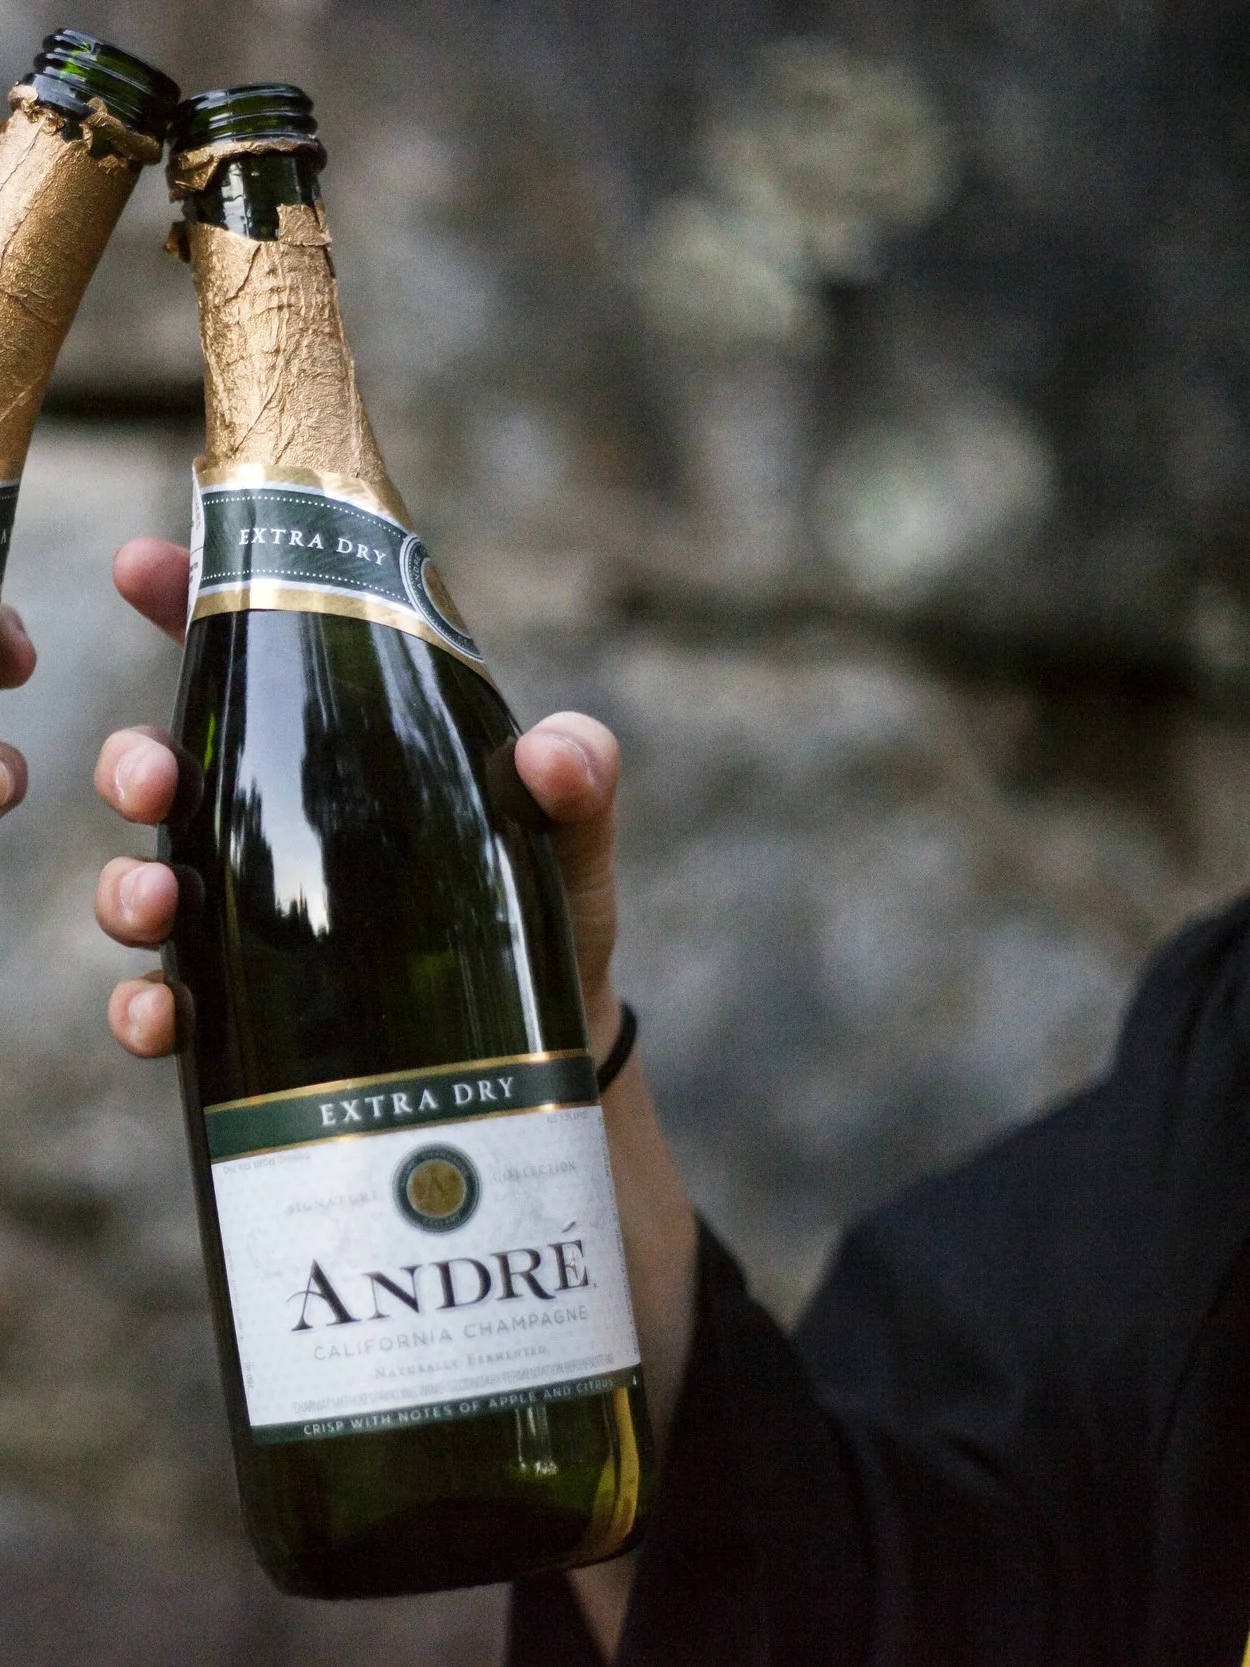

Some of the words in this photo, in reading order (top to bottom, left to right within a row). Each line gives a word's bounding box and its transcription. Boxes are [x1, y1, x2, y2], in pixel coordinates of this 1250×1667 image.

[238, 528, 324, 550] EXTRA
[336, 537, 388, 566] DRY
[319, 1090, 440, 1128] EXTRA
[453, 1076, 515, 1105] DRY
[286, 1222, 591, 1332] ANDRÉ
[314, 1328, 453, 1362] CALIFORNIA
[463, 1304, 589, 1338] CHAMPAGNE
[303, 1421, 344, 1436] CRISP
[350, 1415, 392, 1430] WITH
[398, 1406, 453, 1423] NOTES
[459, 1401, 480, 1413] OF
[488, 1392, 537, 1409] APPLE
[543, 1386, 572, 1400] AND
